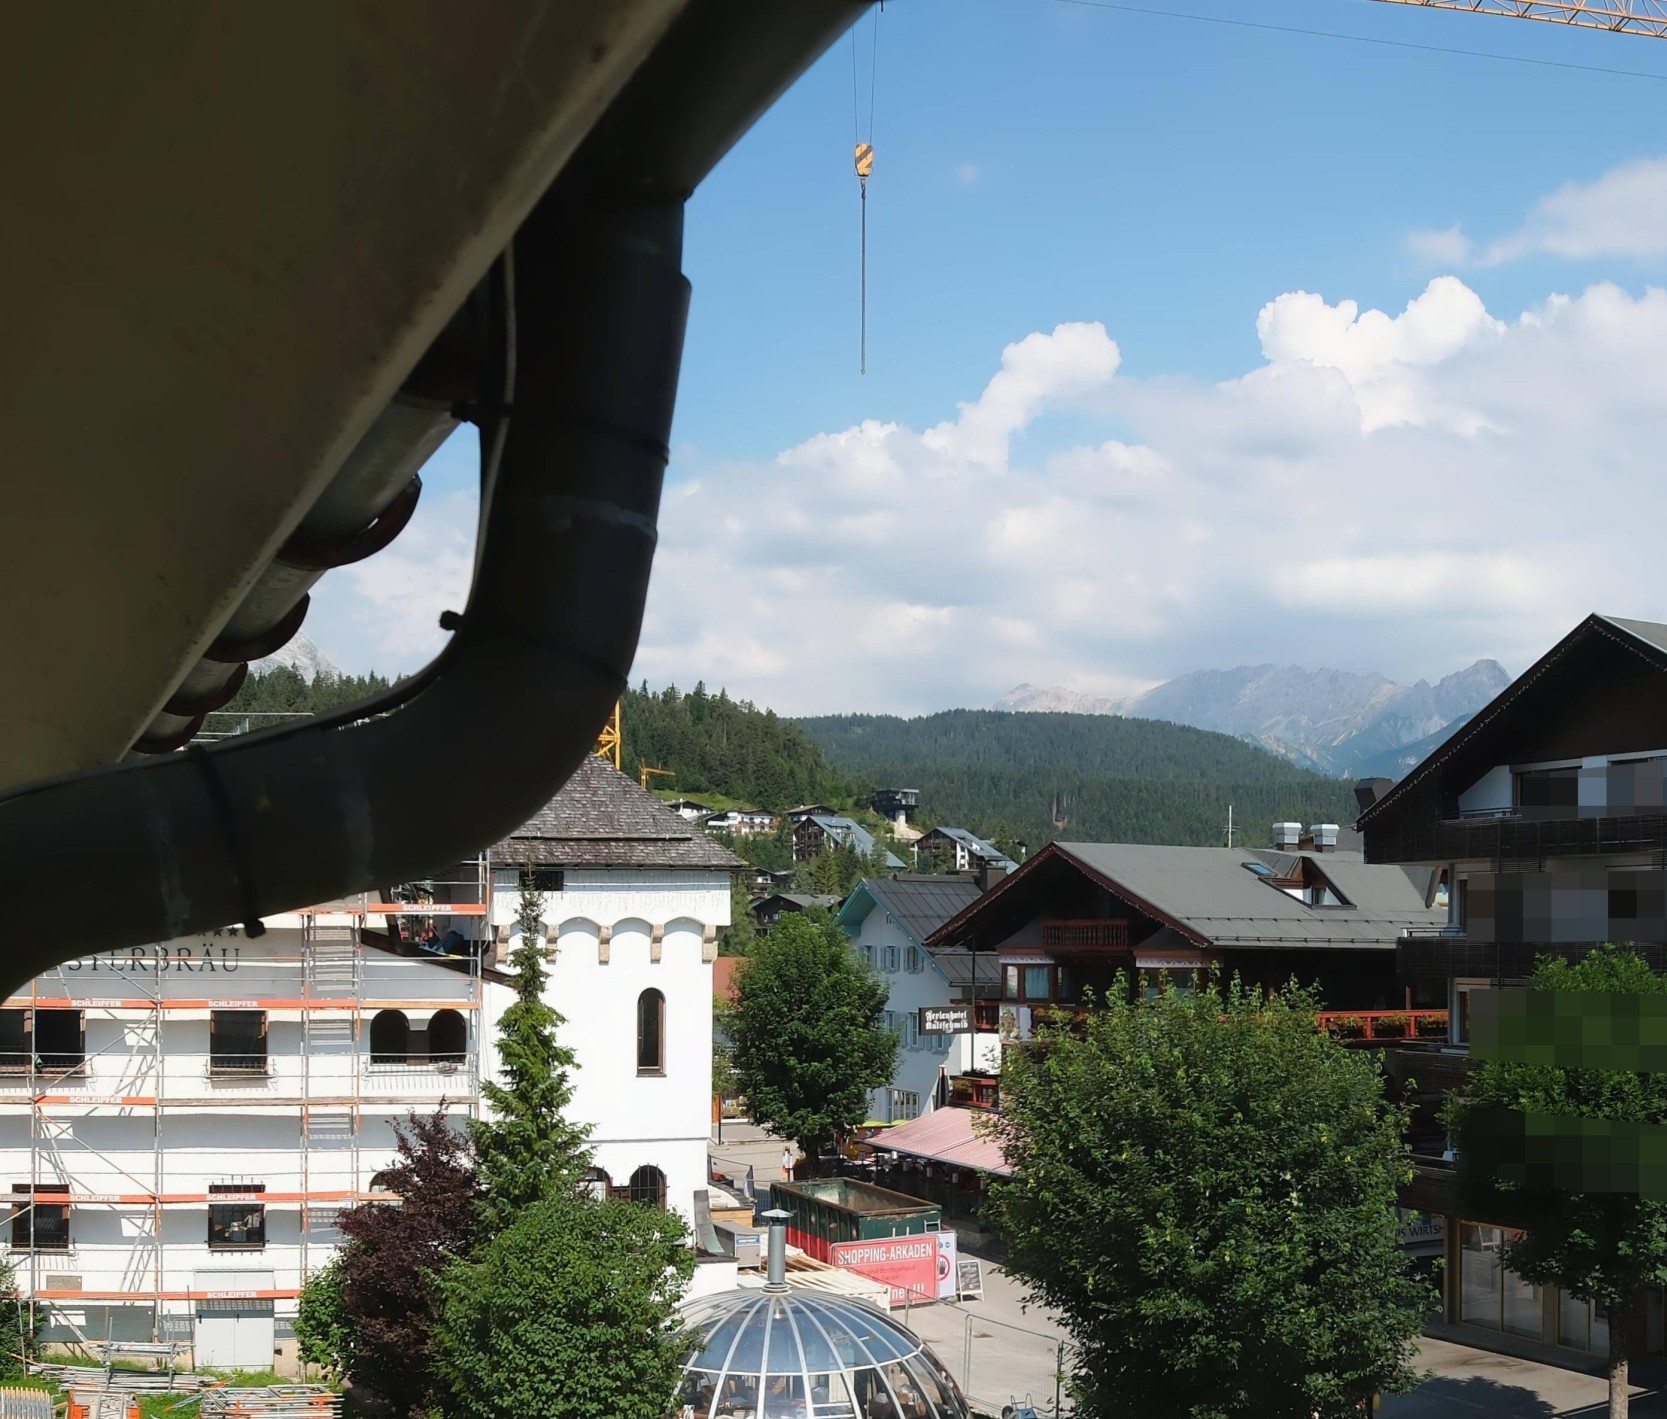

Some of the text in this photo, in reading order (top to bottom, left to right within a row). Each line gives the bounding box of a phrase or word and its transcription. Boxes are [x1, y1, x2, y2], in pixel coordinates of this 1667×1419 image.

[50, 944, 241, 972] STERBRÄU
[71, 999, 122, 1007] SCHLEIPFER
[69, 1194, 121, 1202] SCHLEIPFER
[838, 1243, 933, 1265] SHOPPING-ARKADEN
